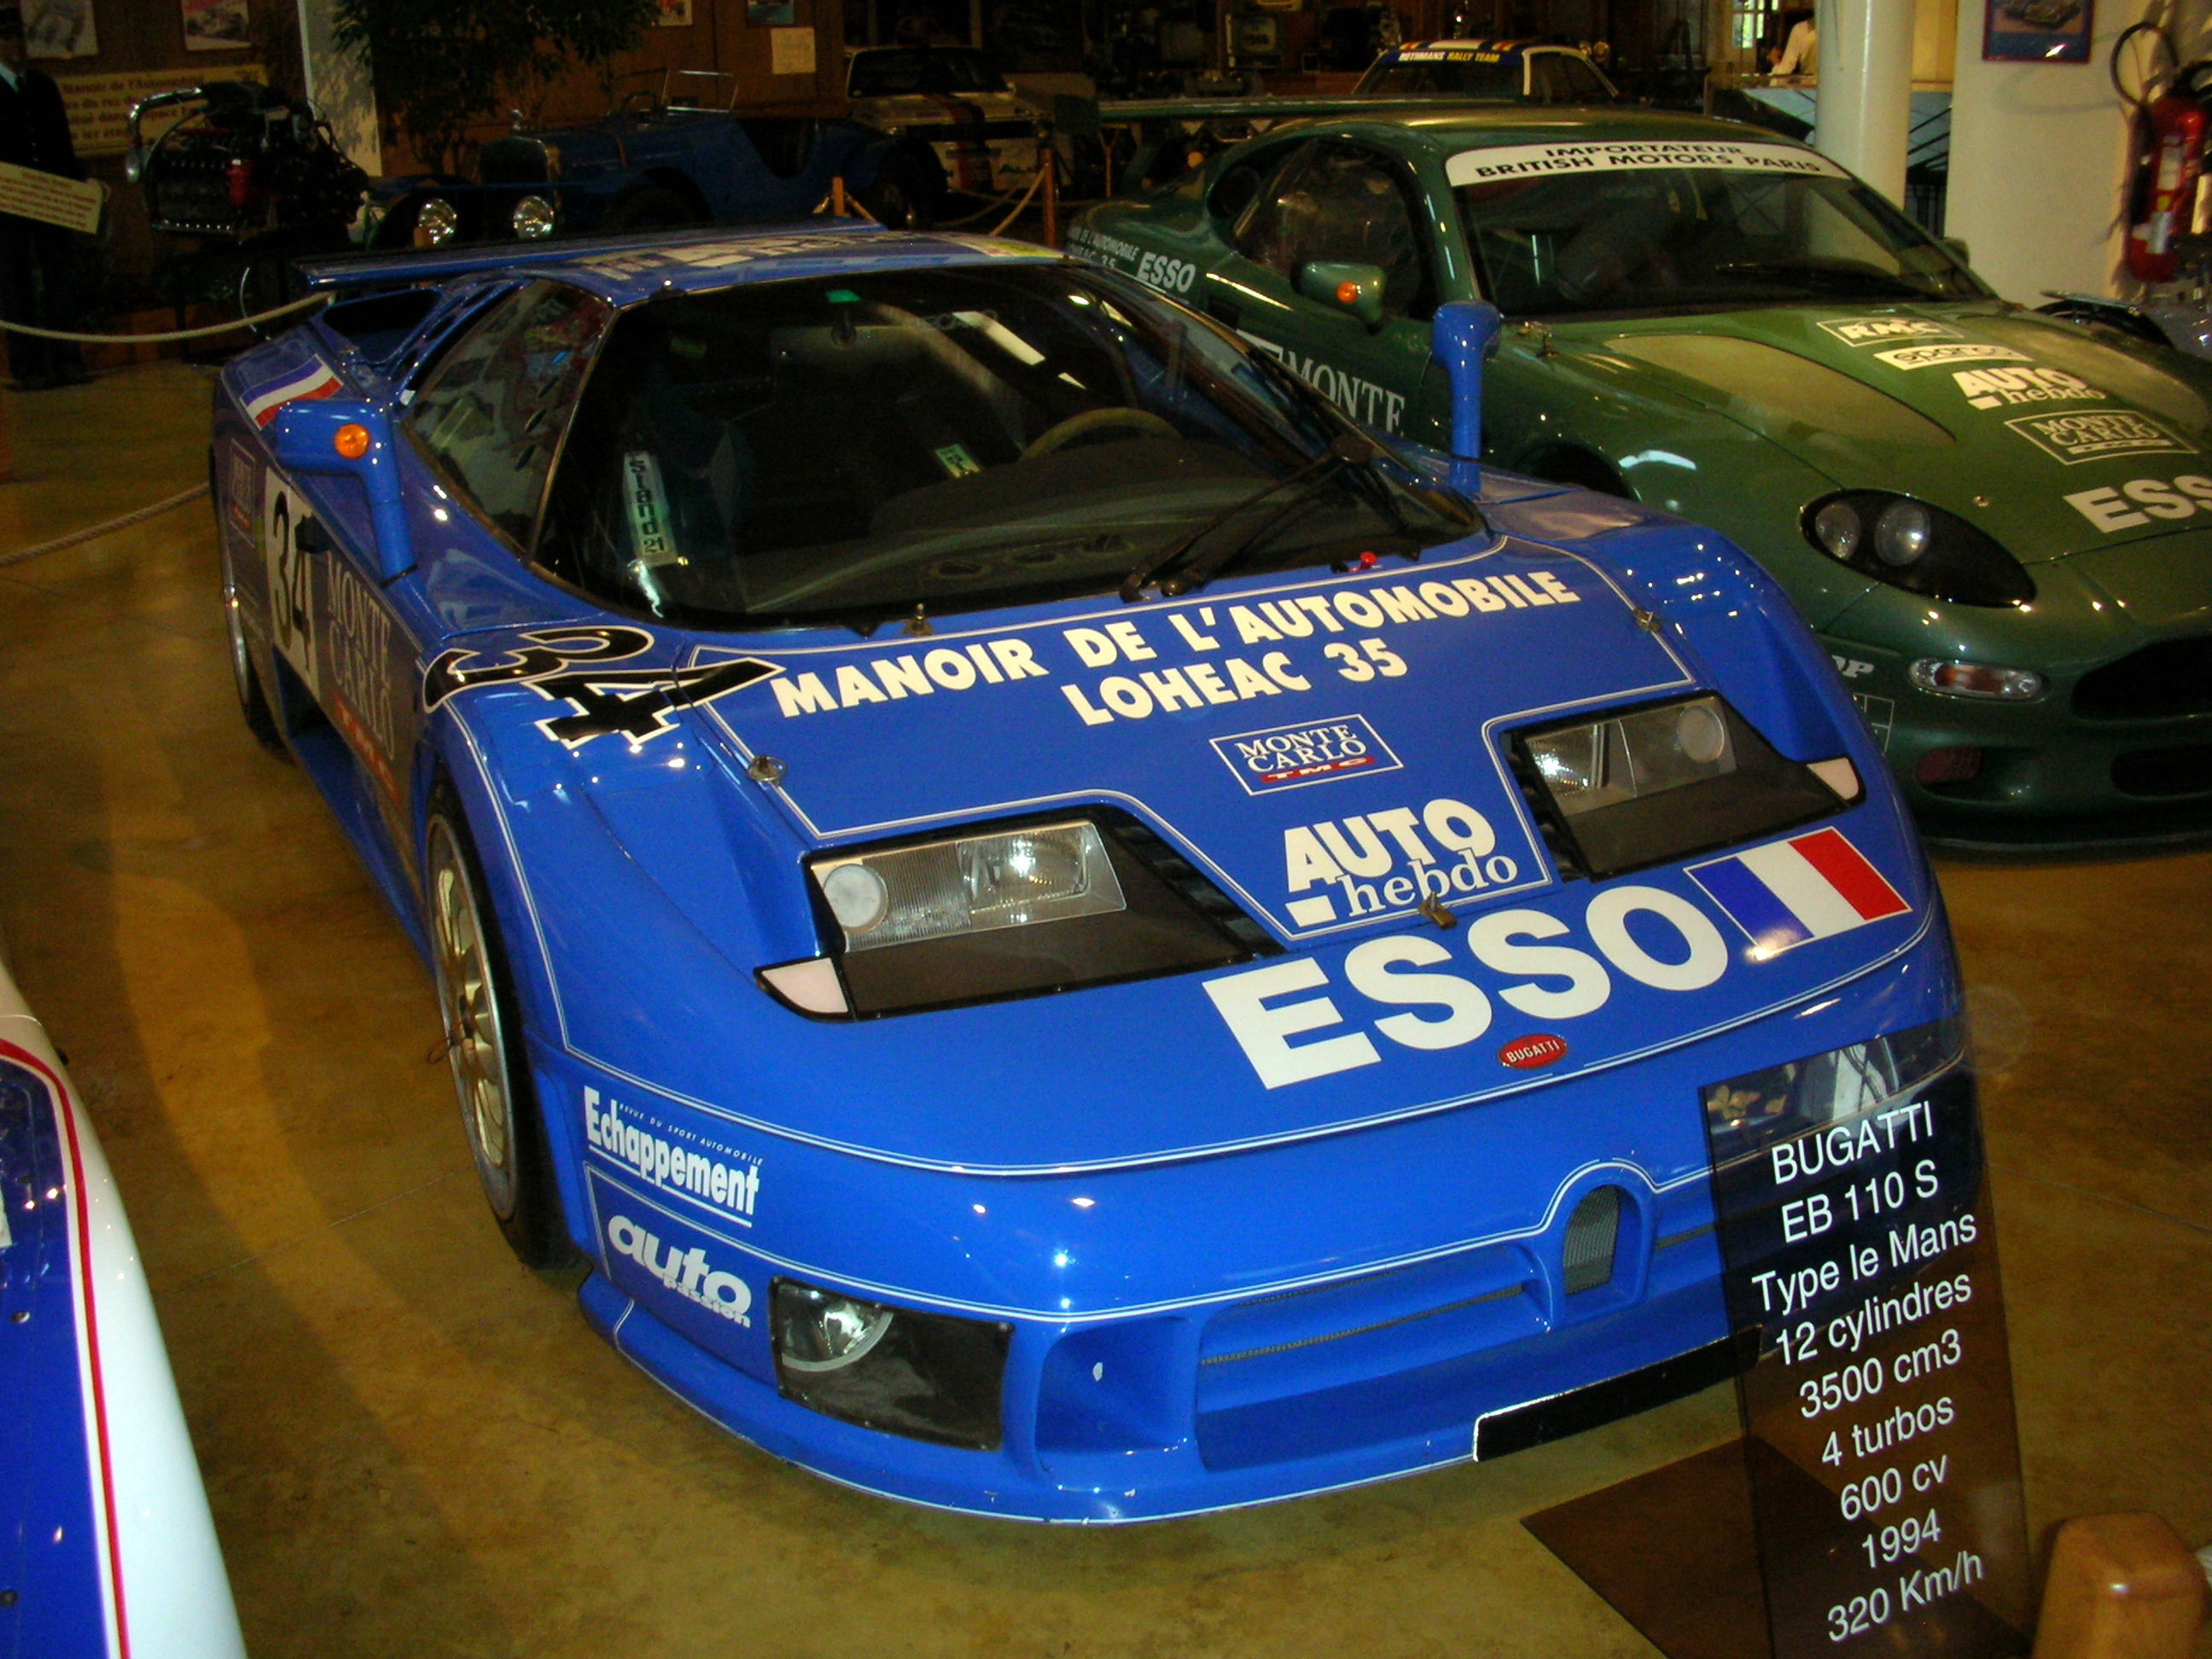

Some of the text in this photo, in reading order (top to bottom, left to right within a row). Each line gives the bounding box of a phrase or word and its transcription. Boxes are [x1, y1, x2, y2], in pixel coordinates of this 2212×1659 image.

[1475, 52, 1500, 63] TEAM
[1476, 153, 1820, 178] BRITISH MOTORS PARIS
[1545, 144, 1745, 157] IMPORTATEUR
[1137, 252, 1196, 293] ESSO
[1838, 318, 1941, 339] RMC
[1288, 350, 1406, 435] MONTE
[1952, 367, 2089, 399] AUTO
[1998, 387, 2108, 405] hebdo
[2032, 416, 2136, 434] MONTE
[2050, 424, 2160, 445] CARLO
[328, 550, 391, 671] MONTE
[770, 571, 1581, 719] MANOIR DE L'AUTOMOBILE
[329, 620, 395, 761] CARLO
[423, 626, 787, 749] 34
[1060, 637, 1408, 726] LOHEAC 35
[1234, 724, 1358, 759] MONTE
[1247, 739, 1367, 773] CARLO
[1267, 757, 1370, 781] TMC
[1284, 798, 1496, 894] AUTO
[1336, 847, 1518, 918] hebdo
[1201, 885, 1729, 1091] ESSO
[1505, 1039, 1561, 1063] BUGATTI
[584, 1085, 760, 1216] Echappement
[619, 1103, 764, 1166] REVUE DU SPORT AUTOMOBILE
[1771, 1100, 1933, 1185] BUGATTI
[1781, 1158, 1939, 1243] EB 110 S
[608, 1214, 752, 1316] auto
[1751, 1213, 1977, 1316] Type le Mans
[1776, 1273, 1972, 1365] 12 cylindres
[1799, 1328, 1963, 1419] 3500 cm3
[1821, 1396, 1955, 1467] 4 turbos
[1840, 1454, 1947, 1521] 600 cv
[1861, 1508, 1941, 1569] 1994
[1827, 1550, 1983, 1642] 320 Km/h
